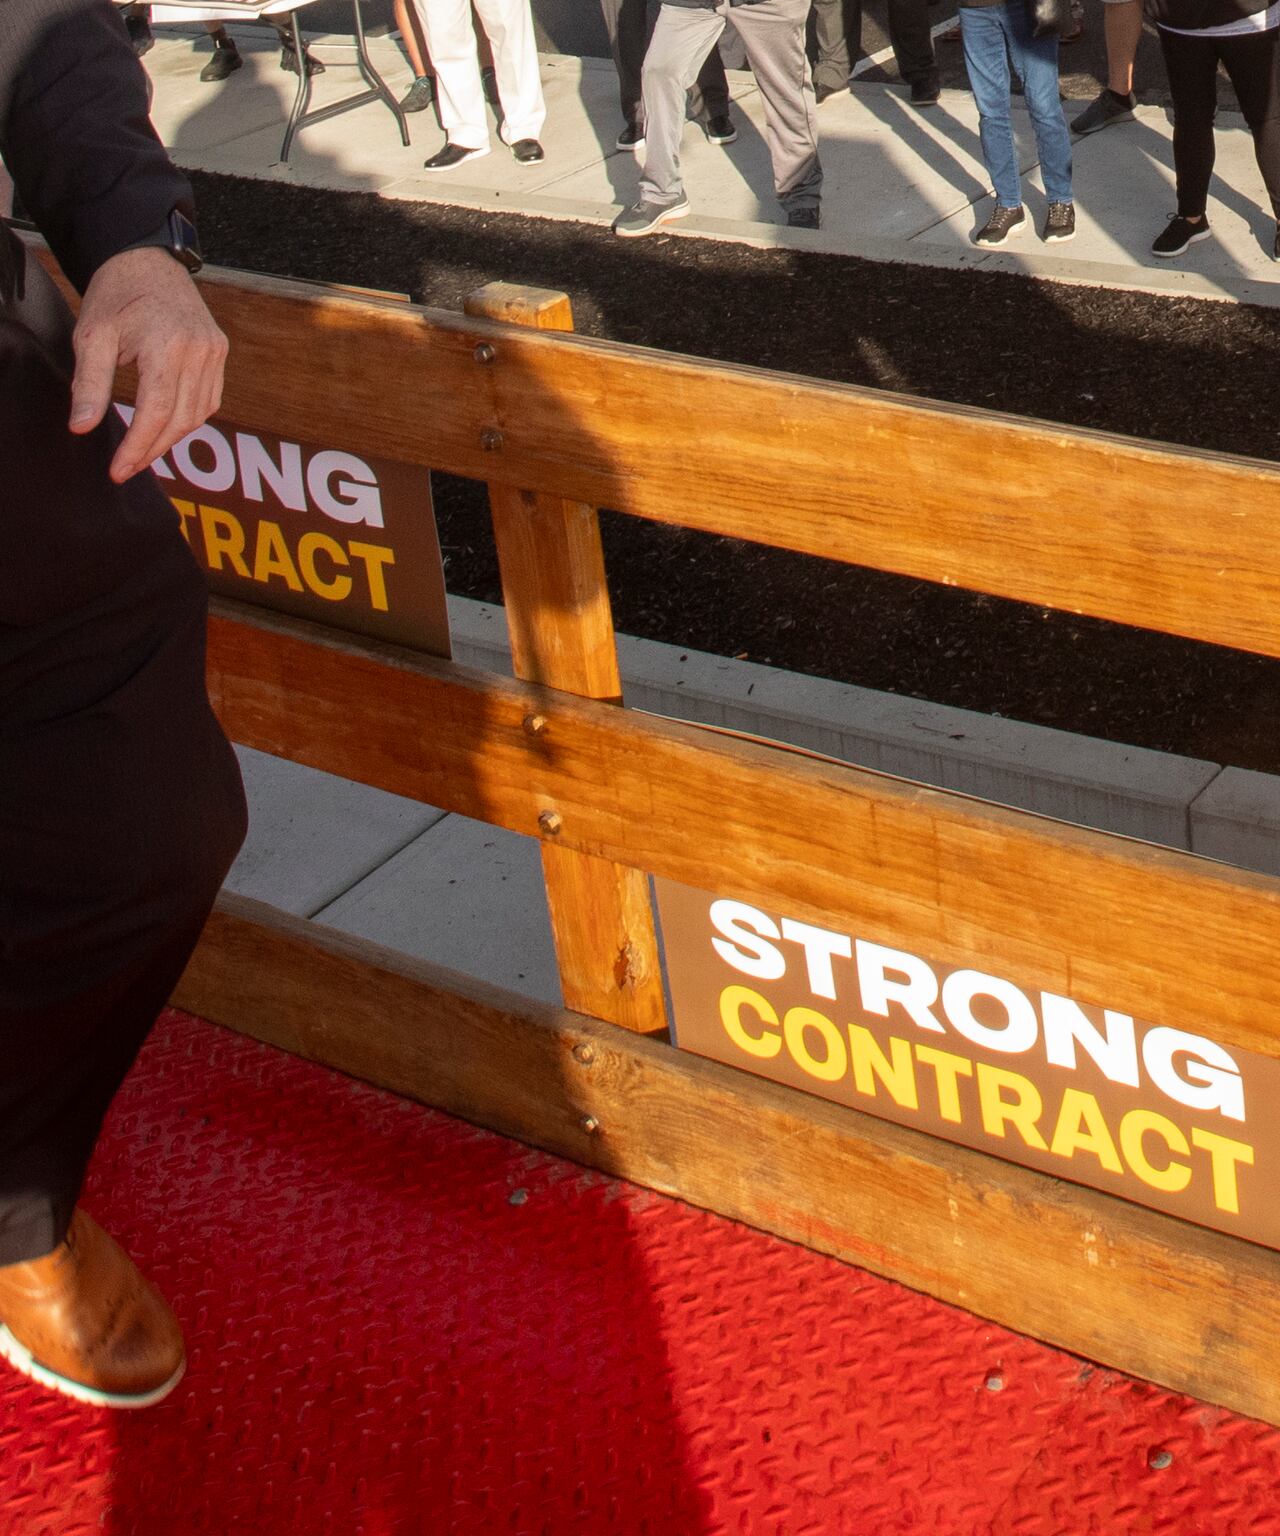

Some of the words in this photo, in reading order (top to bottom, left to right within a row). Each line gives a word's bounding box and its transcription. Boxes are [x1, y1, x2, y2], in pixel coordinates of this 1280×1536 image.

[170, 496, 396, 612] RACT
[709, 898, 1247, 1123] STRONG
[719, 984, 1255, 1215] CONTRACT
